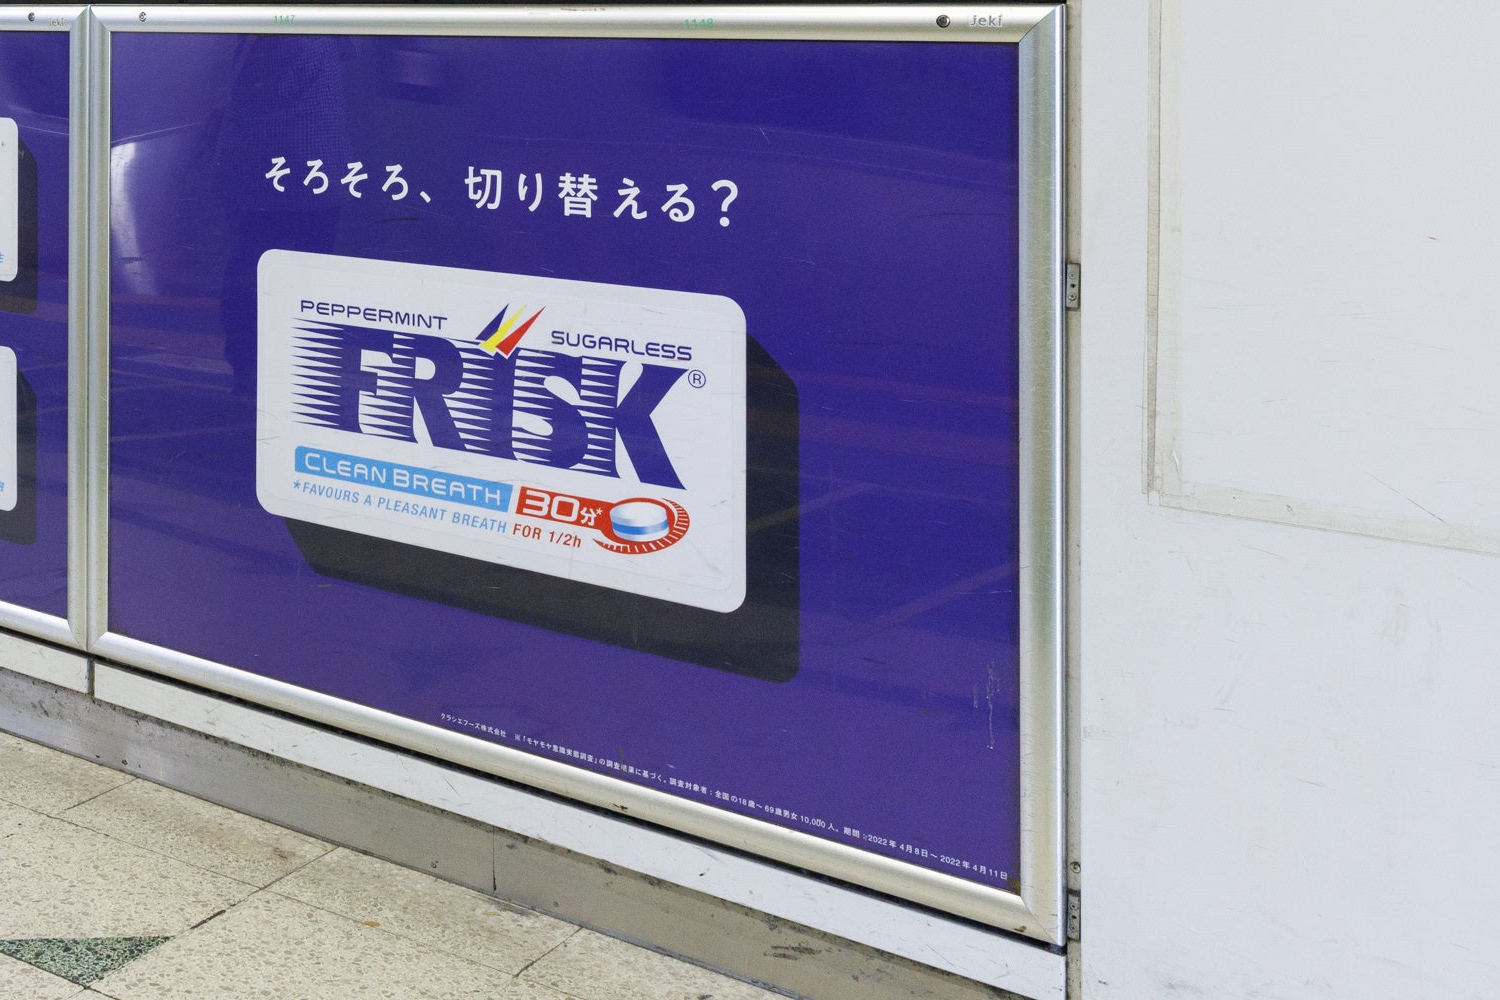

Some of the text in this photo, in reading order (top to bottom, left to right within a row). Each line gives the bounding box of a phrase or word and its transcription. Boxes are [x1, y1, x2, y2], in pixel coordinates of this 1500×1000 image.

[971, 15, 1002, 27] jeki
[300, 300, 448, 330] PEPPERMINT
[552, 330, 692, 361] SUGARLESS
[291, 318, 689, 491] FRISK
[305, 453, 386, 484] CLEAN
[393, 467, 500, 506] BREATH
[364, 493, 373, 506] A
[378, 495, 447, 522] PLEASANT
[452, 511, 507, 533] BREATH
[513, 523, 542, 541] FOR
[549, 529, 581, 548] 1/2h
